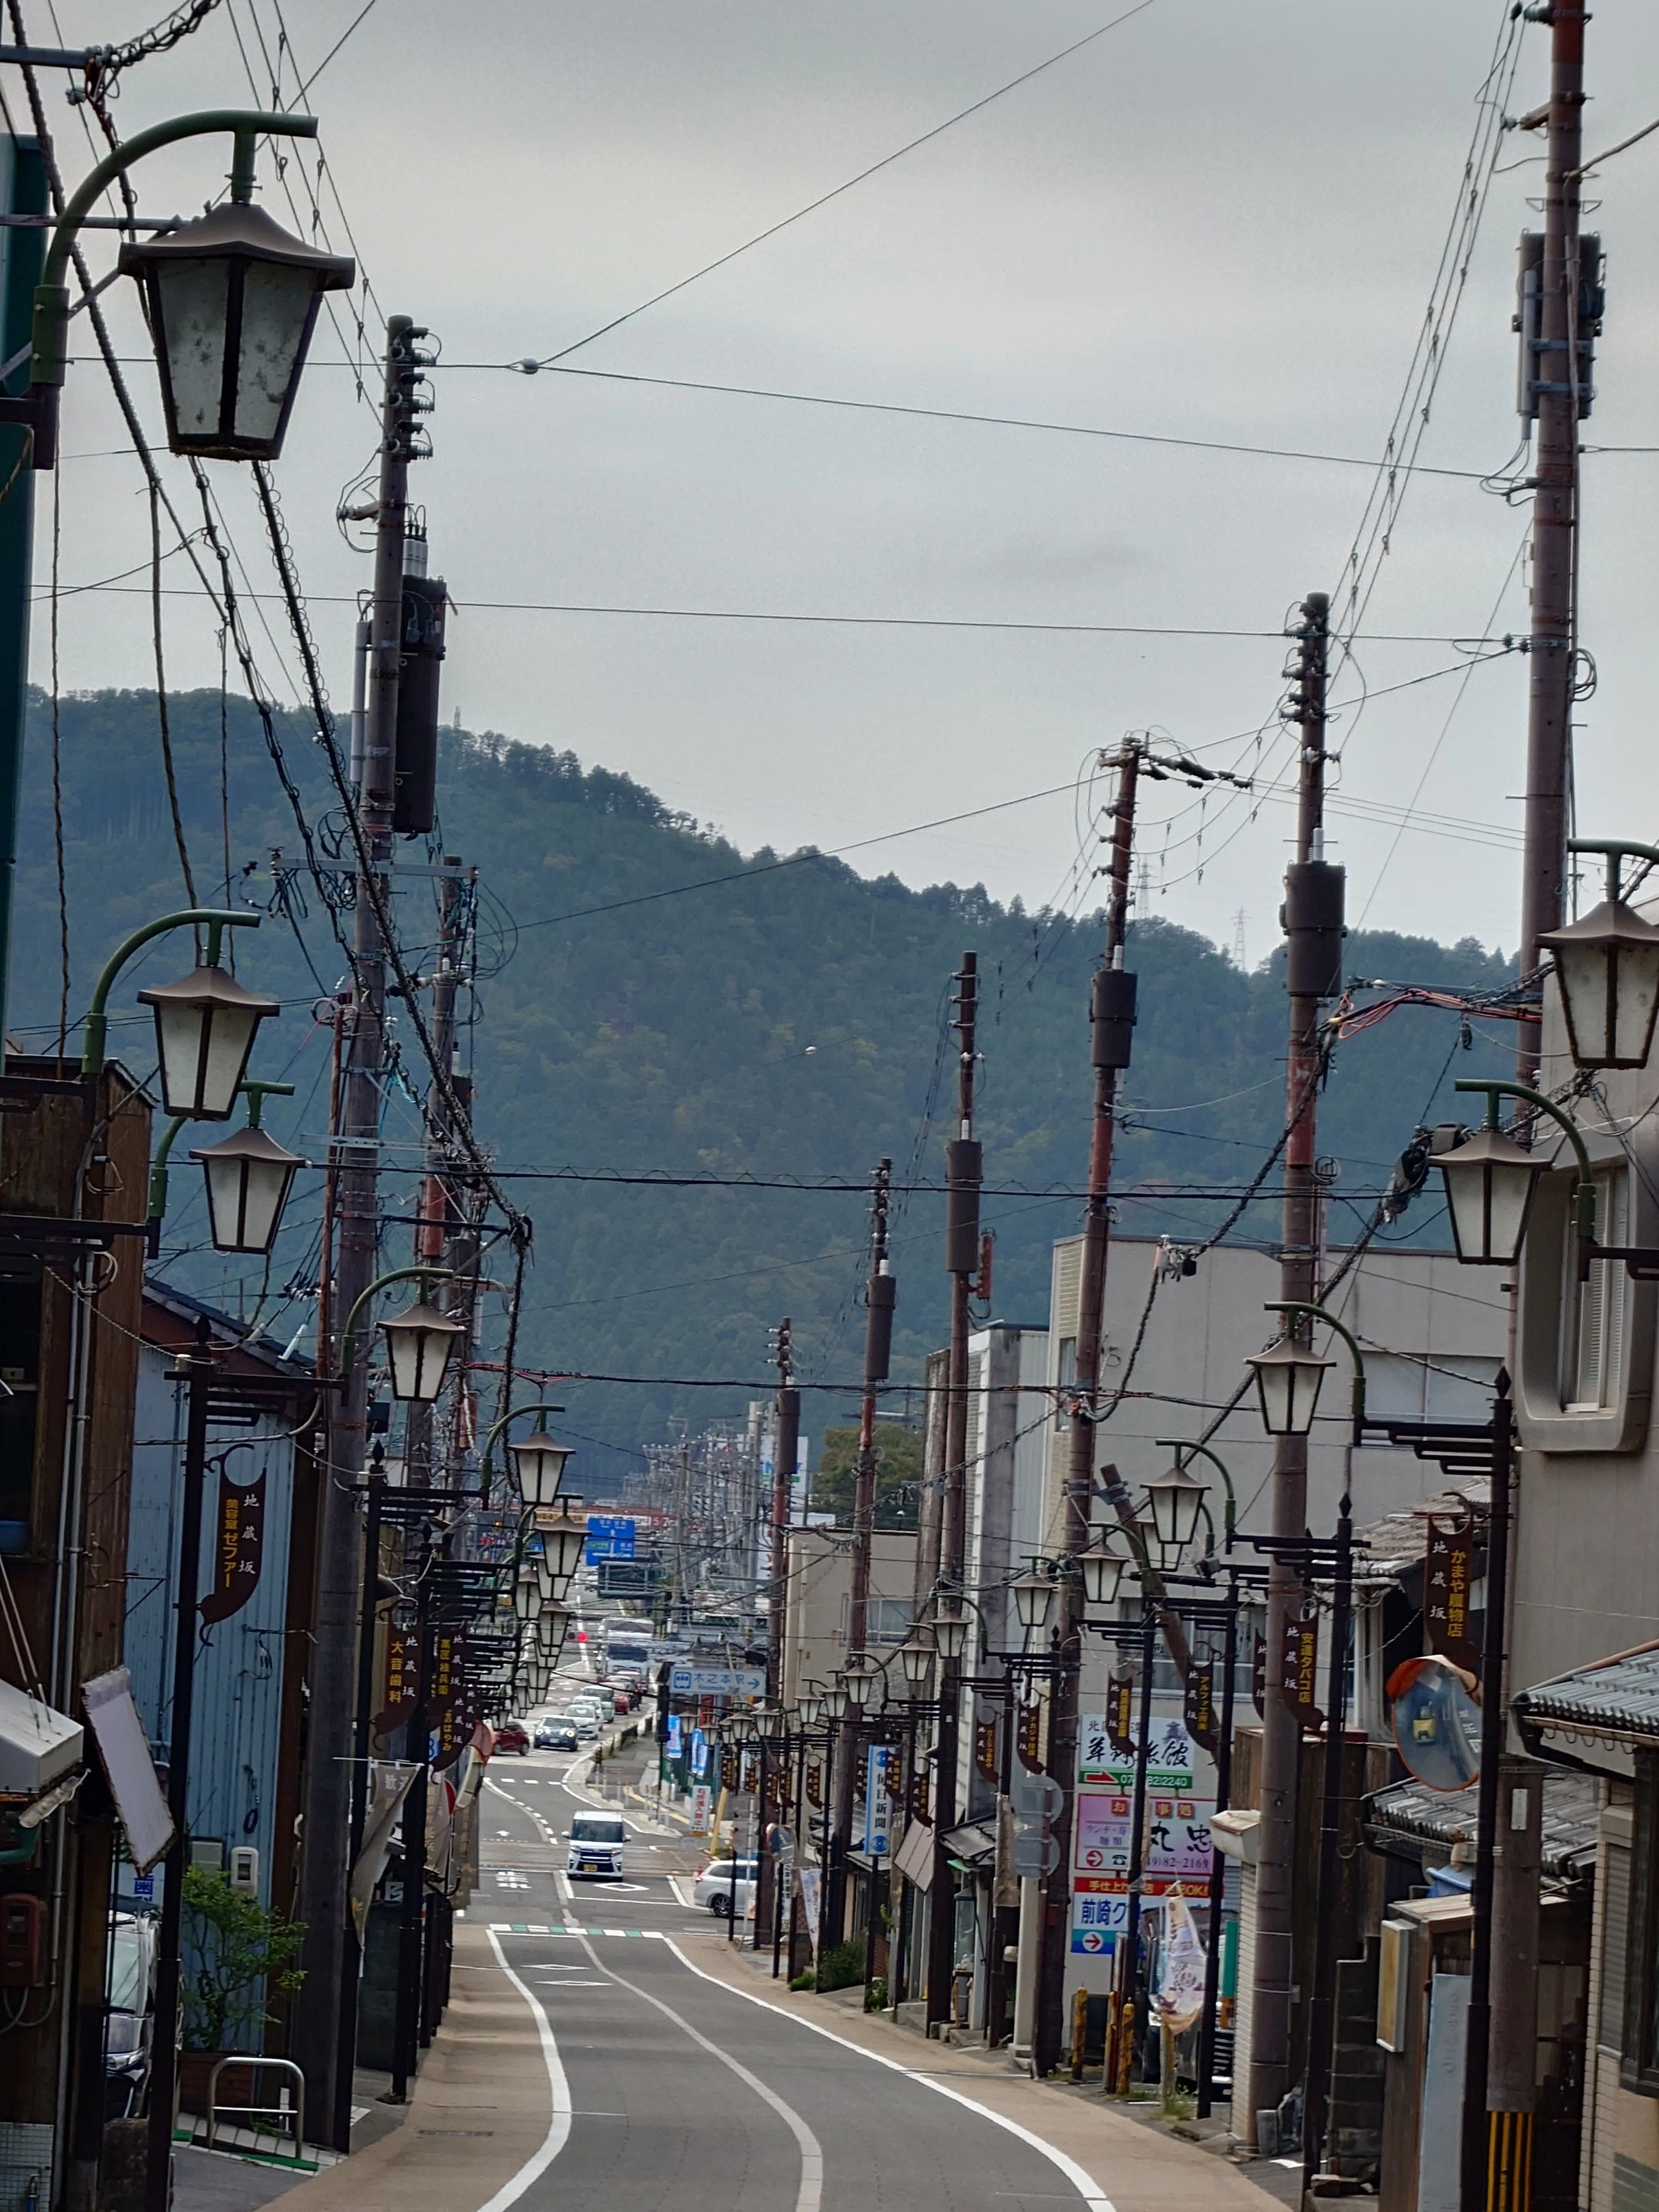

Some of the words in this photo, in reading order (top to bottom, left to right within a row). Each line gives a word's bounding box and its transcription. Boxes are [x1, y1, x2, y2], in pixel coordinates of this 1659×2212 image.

[238, 1494, 259, 1574] 地蔵坂
[1430, 1540, 1449, 1619] 地蔵坂
[388, 1641, 404, 1703] 大音歯科
[402, 1636, 418, 1697] 地蔵坂
[1284, 1626, 1300, 1689] 地蔵坂
[874, 1773, 887, 1829] 毎日新聞
[1112, 1802, 1193, 1818] お事処
